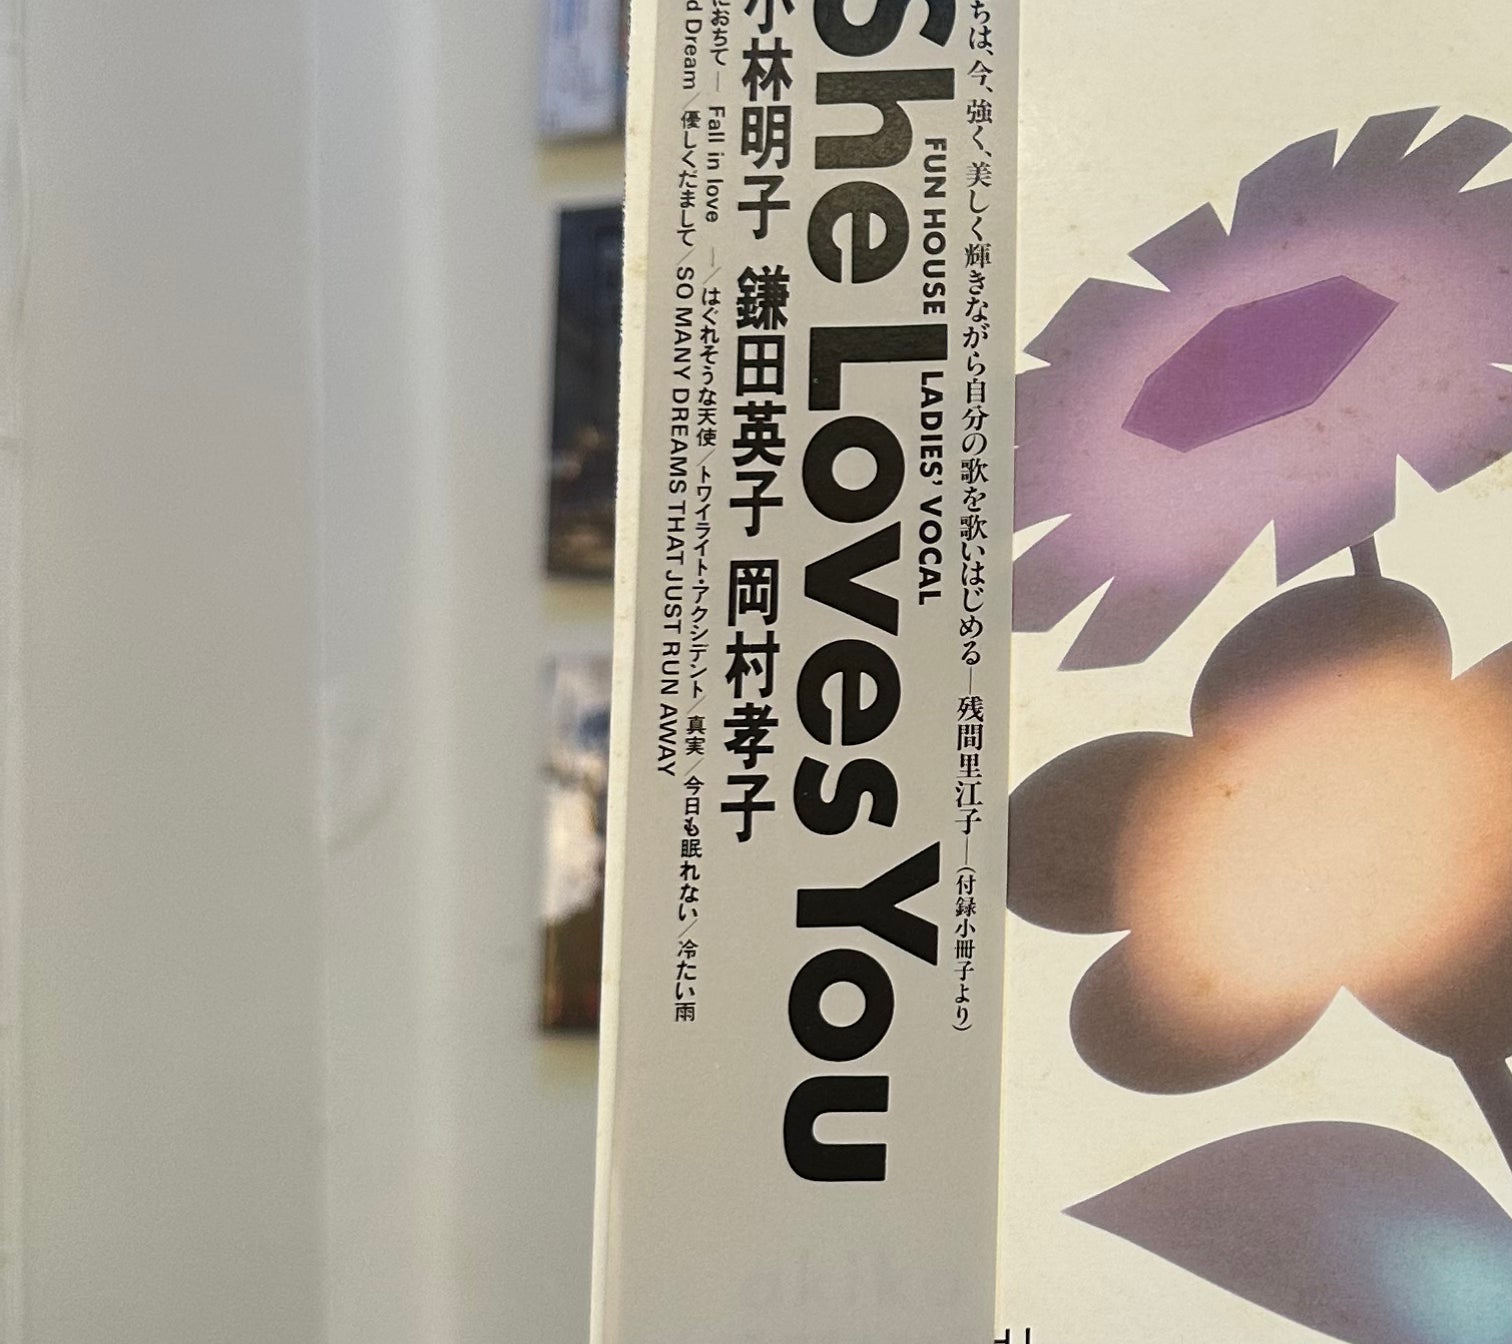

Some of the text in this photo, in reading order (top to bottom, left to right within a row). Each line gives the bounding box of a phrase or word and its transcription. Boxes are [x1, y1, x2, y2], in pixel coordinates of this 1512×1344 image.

[704, 150, 727, 172] in
[706, 104, 727, 145] Fall
[702, 177, 726, 224] love
[922, 136, 949, 200] FUN
[920, 207, 948, 317] HOUSE
[671, 305, 695, 382] MANY
[727, 263, 792, 539] 鎌田英子
[667, 386, 692, 496] DREAMS
[665, 499, 687, 563] THAT
[916, 493, 944, 607] VOCAL
[662, 568, 686, 635] JUST
[791, 322, 950, 837] Loves
[659, 640, 682, 697] RUN
[718, 557, 782, 845] 岡村孝子
[656, 702, 680, 778] AWAY
[781, 839, 942, 1184] You
